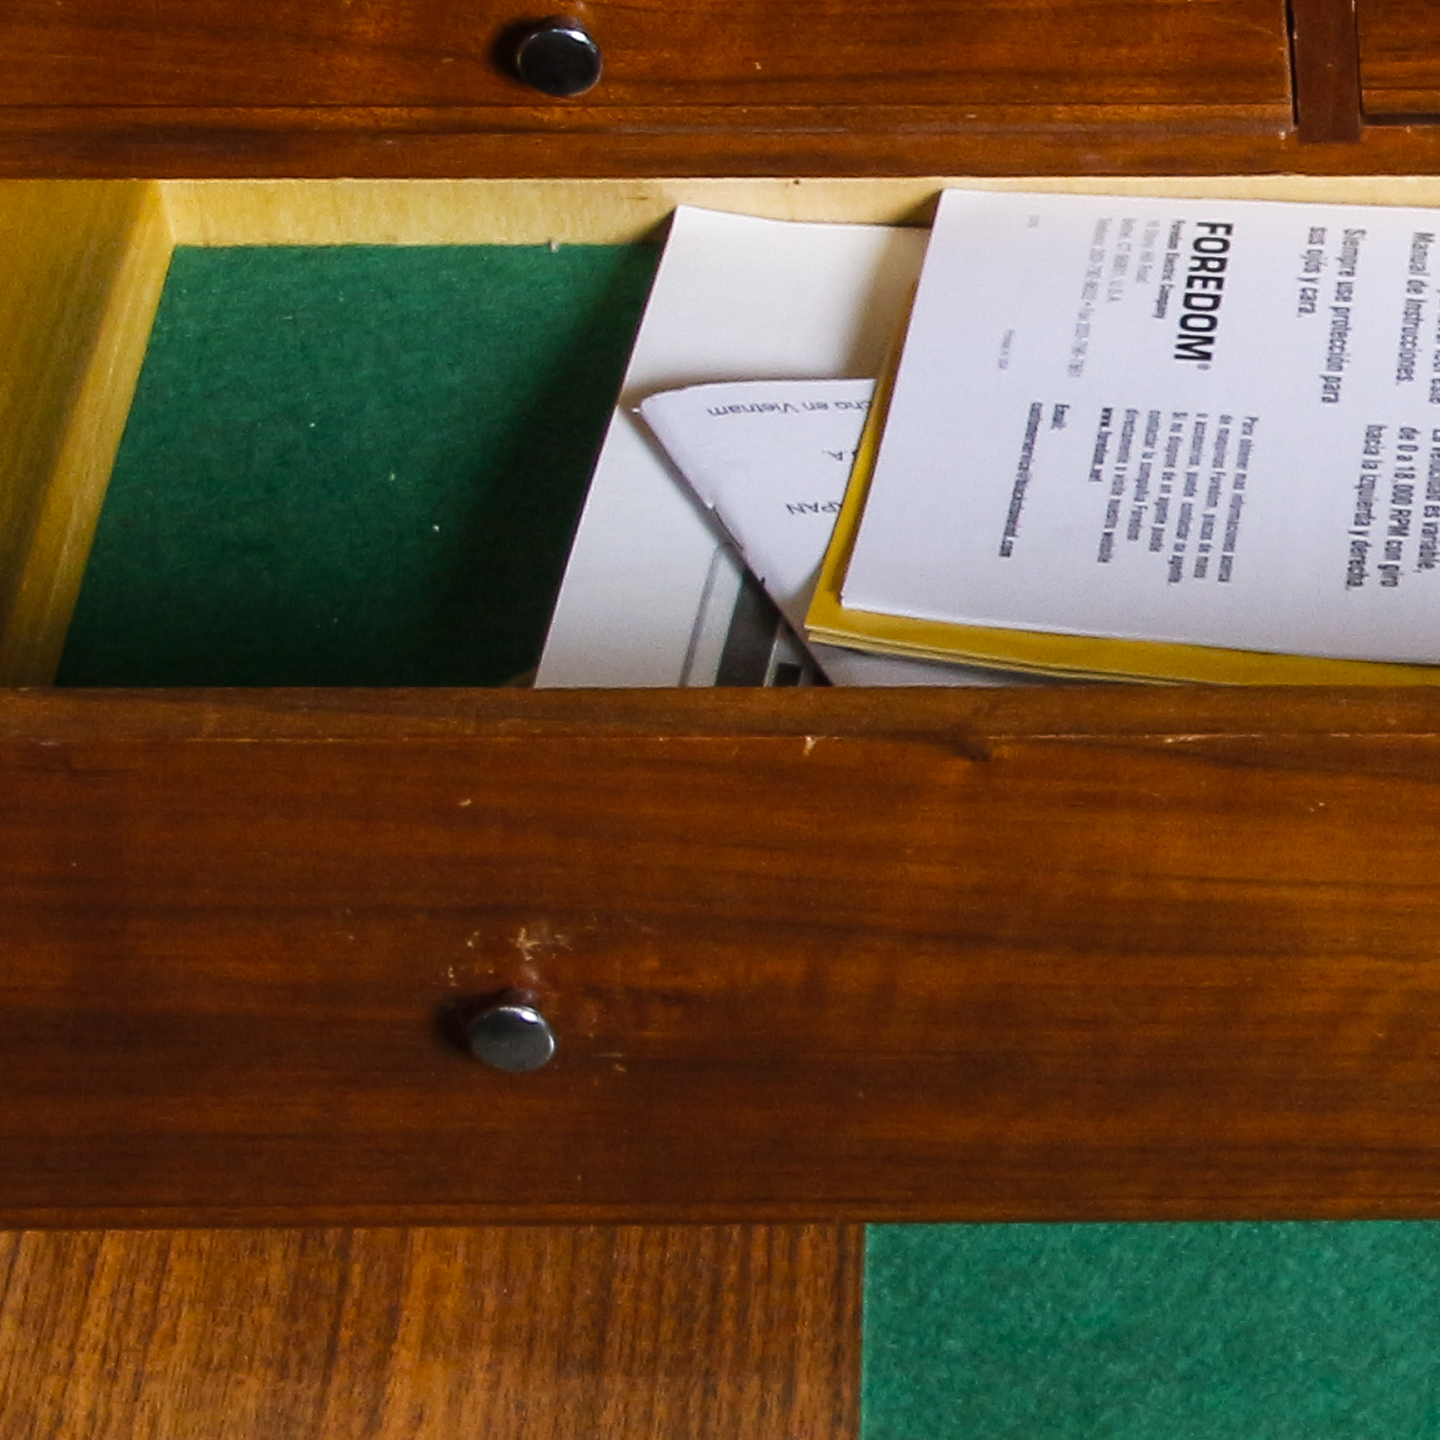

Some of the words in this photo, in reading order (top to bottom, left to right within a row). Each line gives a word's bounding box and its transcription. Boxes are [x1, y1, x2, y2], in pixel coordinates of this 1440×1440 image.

[1336, 229, 1366, 276] Siempre
[1409, 232, 1434, 275] Manual
[1335, 282, 1352, 302] use
[1406, 279, 1428, 294] de
[1320, 375, 1341, 402] para
[707, 401, 798, 418] Vietnam
[804, 401, 828, 410] en
[1398, 427, 1420, 441] de
[1423, 505, 1440, 518] es
[1388, 509, 1411, 537] RPM
[1384, 540, 1403, 560] con
[1377, 564, 1403, 587] giro
